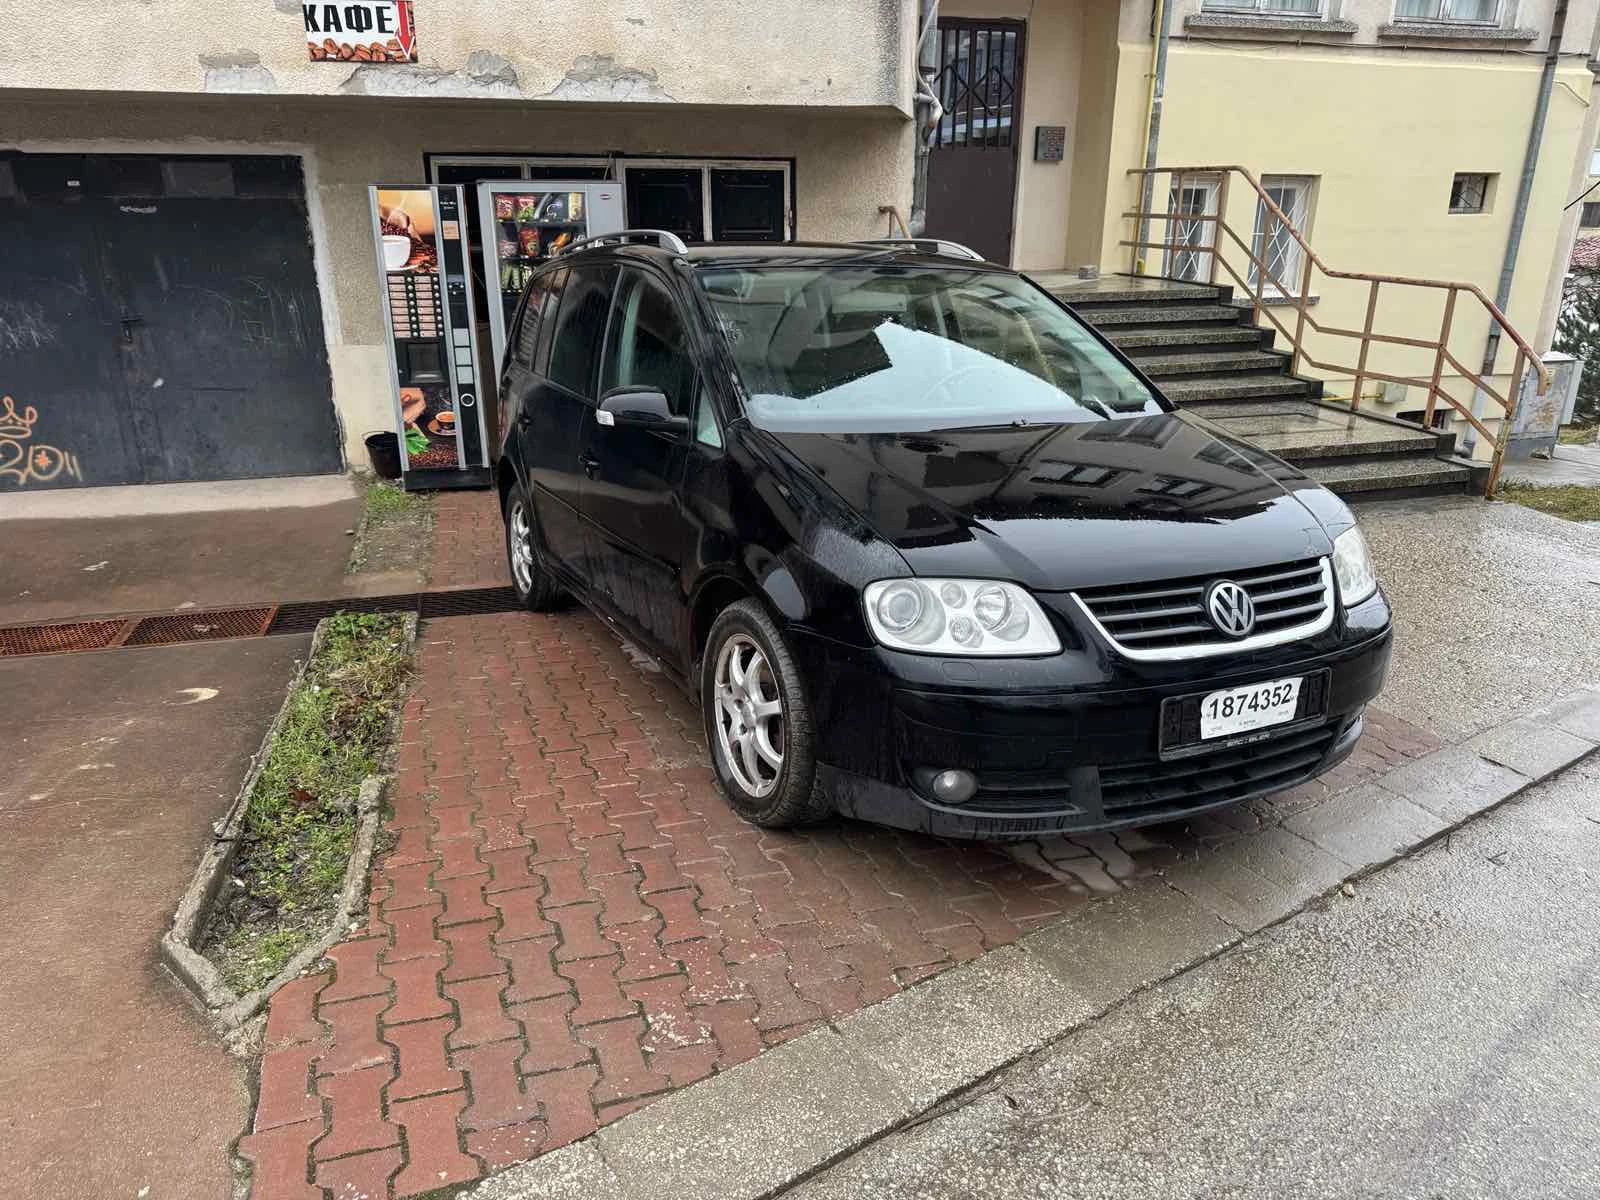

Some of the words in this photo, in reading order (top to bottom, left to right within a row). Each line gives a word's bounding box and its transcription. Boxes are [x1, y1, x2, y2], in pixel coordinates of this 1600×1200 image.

[302, 4, 394, 33] КАФЕ
[1210, 583, 1254, 636] VW
[1209, 683, 1293, 720] 1874352
